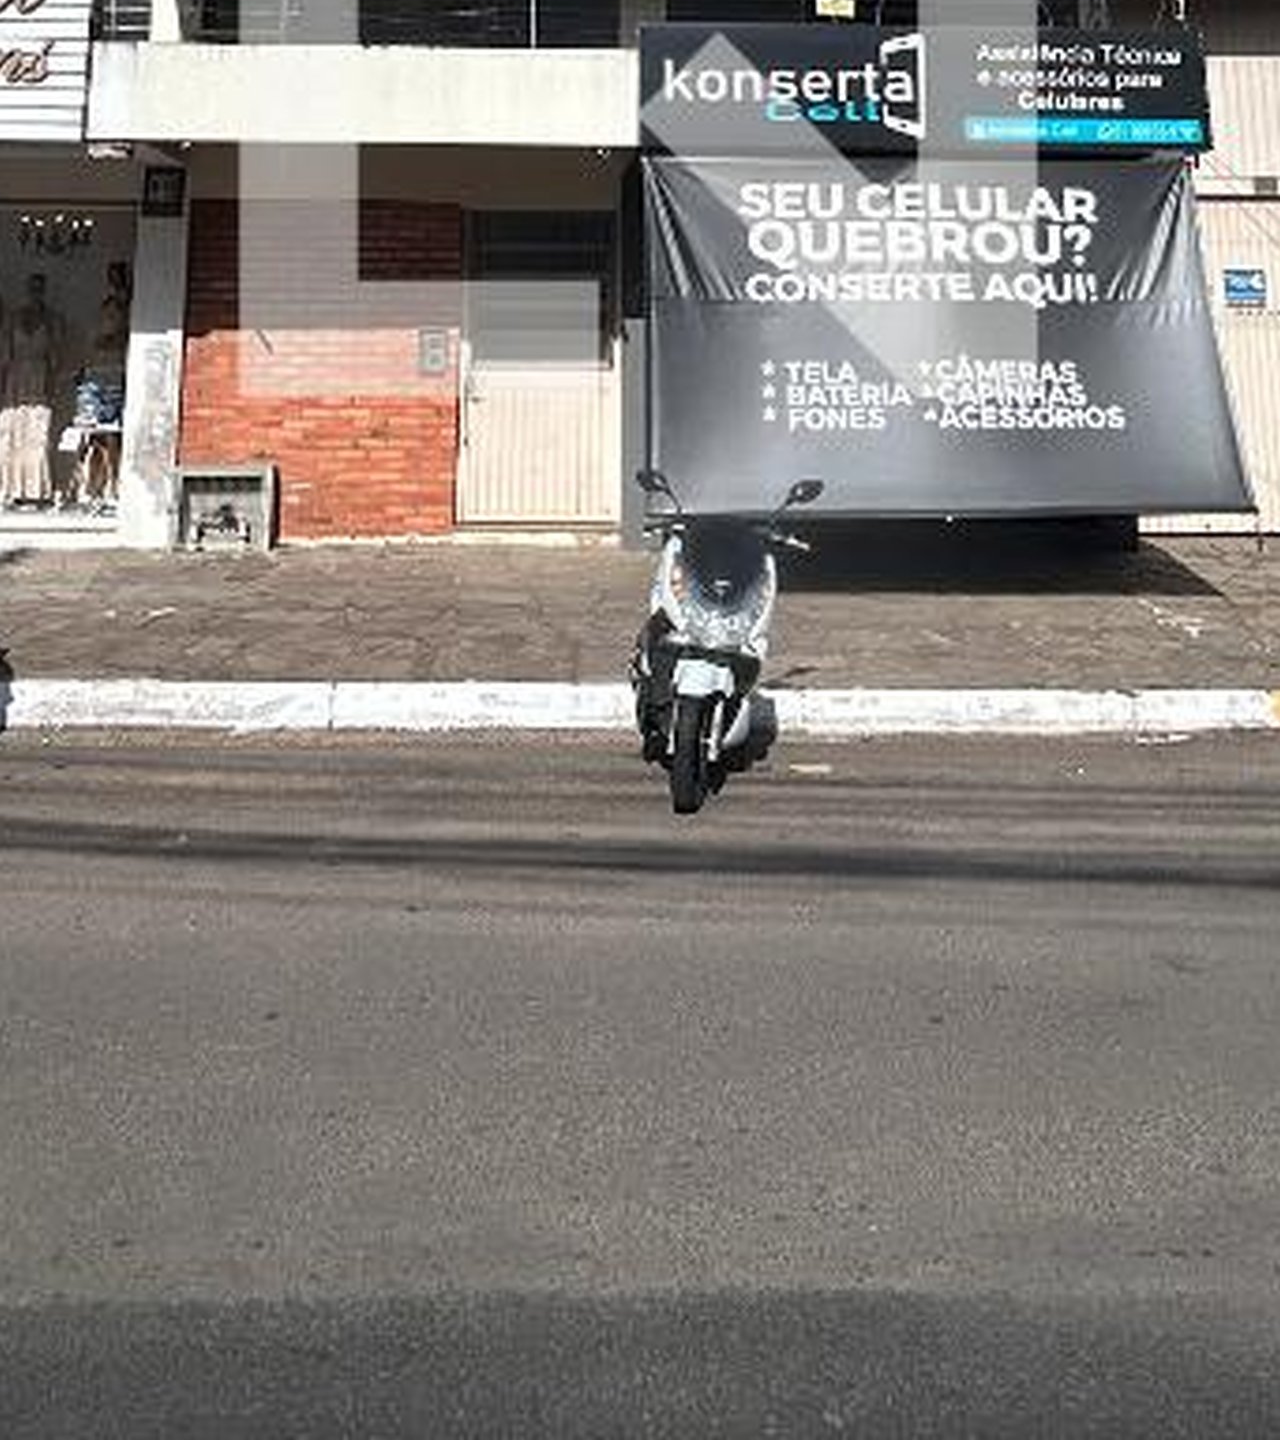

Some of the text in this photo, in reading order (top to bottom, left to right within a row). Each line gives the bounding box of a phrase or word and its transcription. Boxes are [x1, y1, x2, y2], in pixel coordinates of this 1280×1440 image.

[663, 57, 916, 103] konserta
[737, 182, 1098, 223] SEU CELULAR
[747, 219, 1093, 270] QUEBROU?
[745, 273, 975, 303] CONSERTE
[785, 360, 858, 384] TELA
[937, 382, 1088, 407] CAPINHAS
[788, 407, 886, 433] FONES
